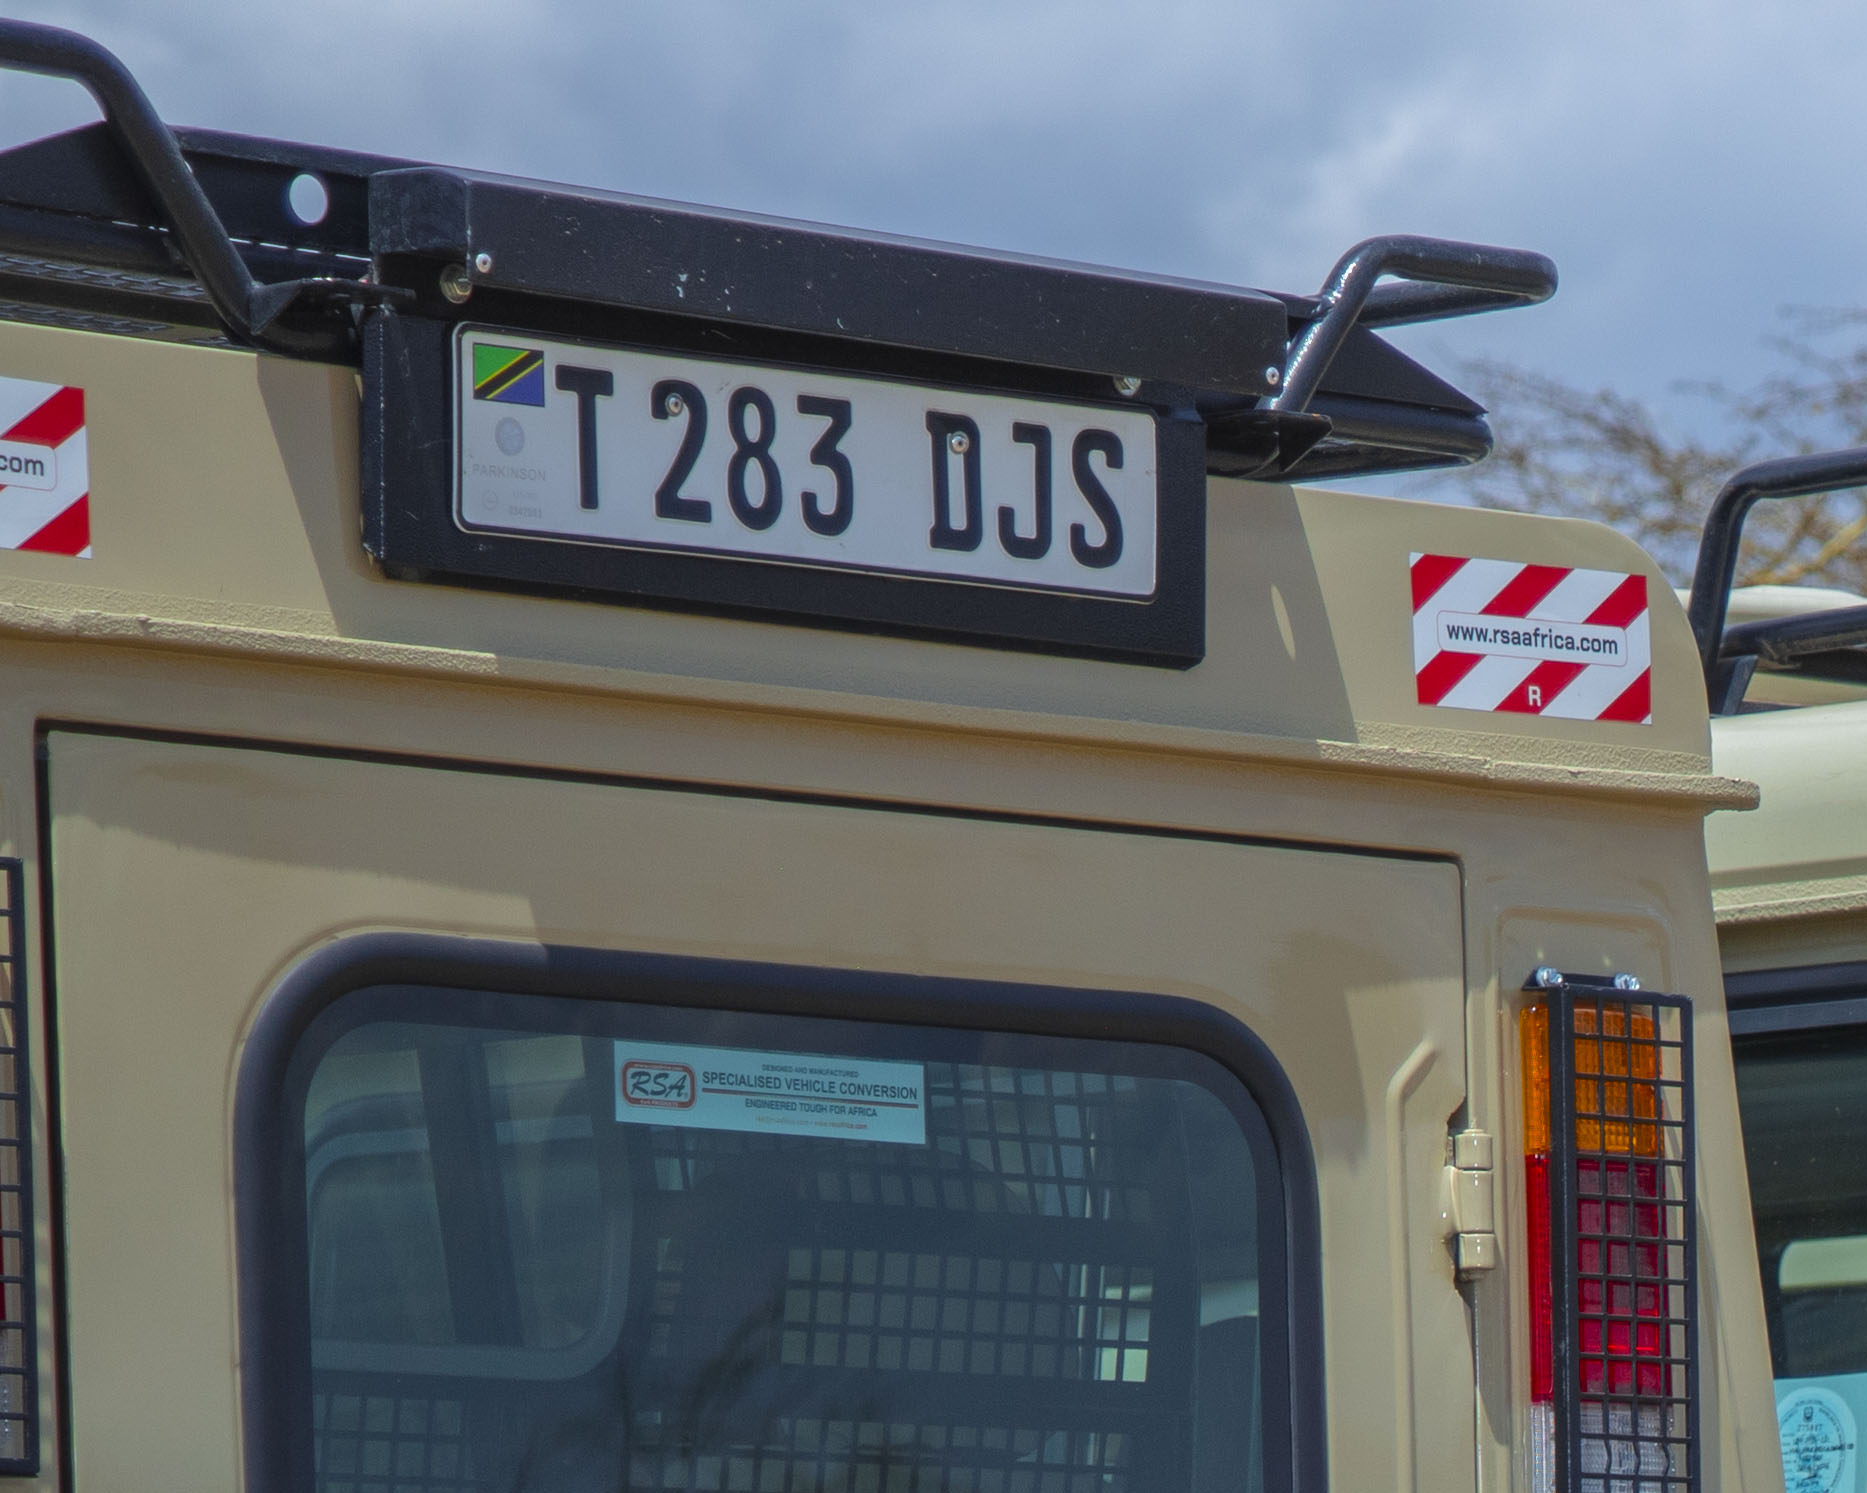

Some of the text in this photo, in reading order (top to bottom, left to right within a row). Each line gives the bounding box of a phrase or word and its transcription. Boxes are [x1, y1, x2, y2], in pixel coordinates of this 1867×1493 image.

[472, 463, 546, 482] PARKINSON
[555, 364, 1124, 569] T 283 DJS
[1447, 623, 1618, 655] www.rsaafrica.com
[1528, 685, 1541, 707] R
[794, 1065, 808, 1074] AND
[630, 1070, 687, 1098] RSA
[702, 1070, 918, 1100] SPECIALISED VEHICLE CONVERSION
[745, 1098, 878, 1118] ENGINEERED TOUGH FOR AFRICA
